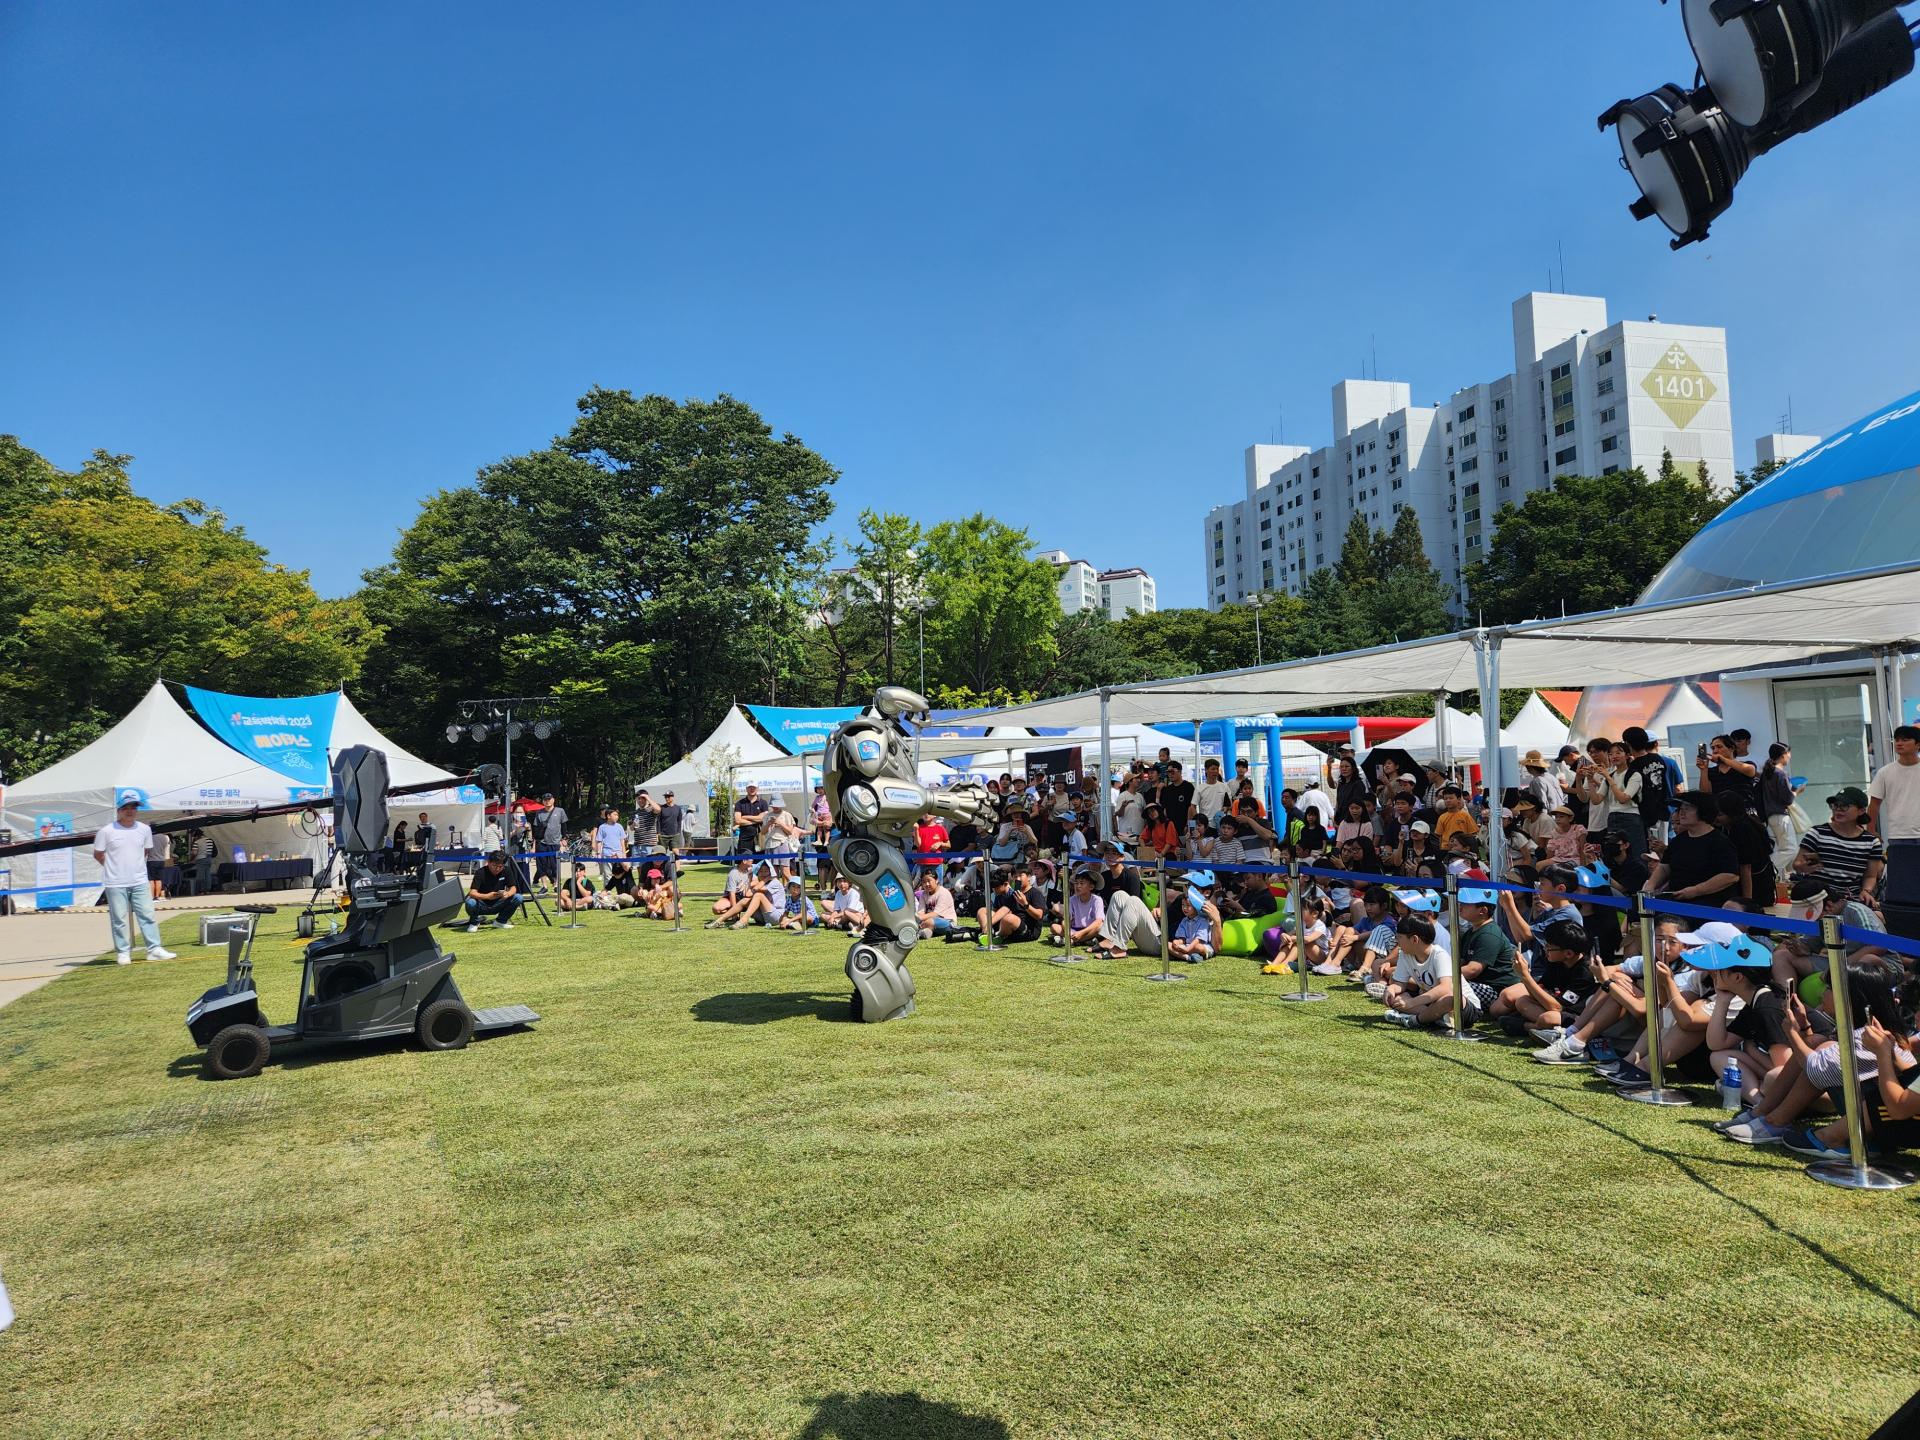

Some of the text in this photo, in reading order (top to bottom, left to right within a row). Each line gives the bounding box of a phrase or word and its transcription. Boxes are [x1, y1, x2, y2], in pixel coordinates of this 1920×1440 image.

[1655, 375, 1704, 399] 1401
[288, 714, 313, 728] 2023
[1234, 718, 1283, 728] SKYKICK
[199, 788, 241, 799] 무드등 제작
